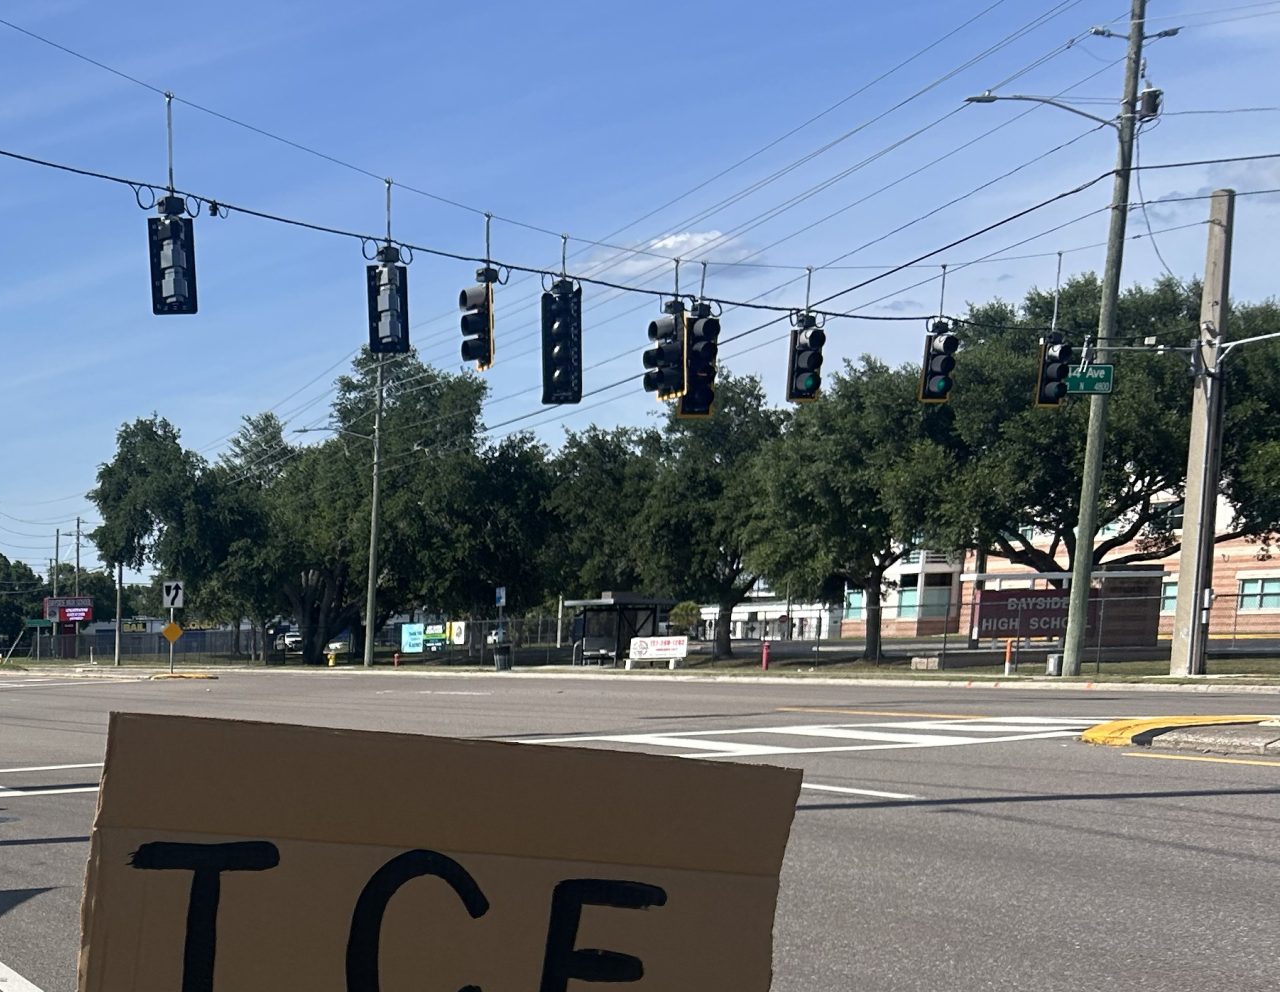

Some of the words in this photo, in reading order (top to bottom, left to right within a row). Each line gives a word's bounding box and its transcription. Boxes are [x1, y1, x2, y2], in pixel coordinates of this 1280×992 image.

[1086, 367, 1105, 378] Ave
[1079, 382, 1085, 390] N
[1007, 597, 1069, 610] BAYSIDE
[982, 618, 1019, 631] HIGH
[1029, 616, 1091, 630] SCHOL
